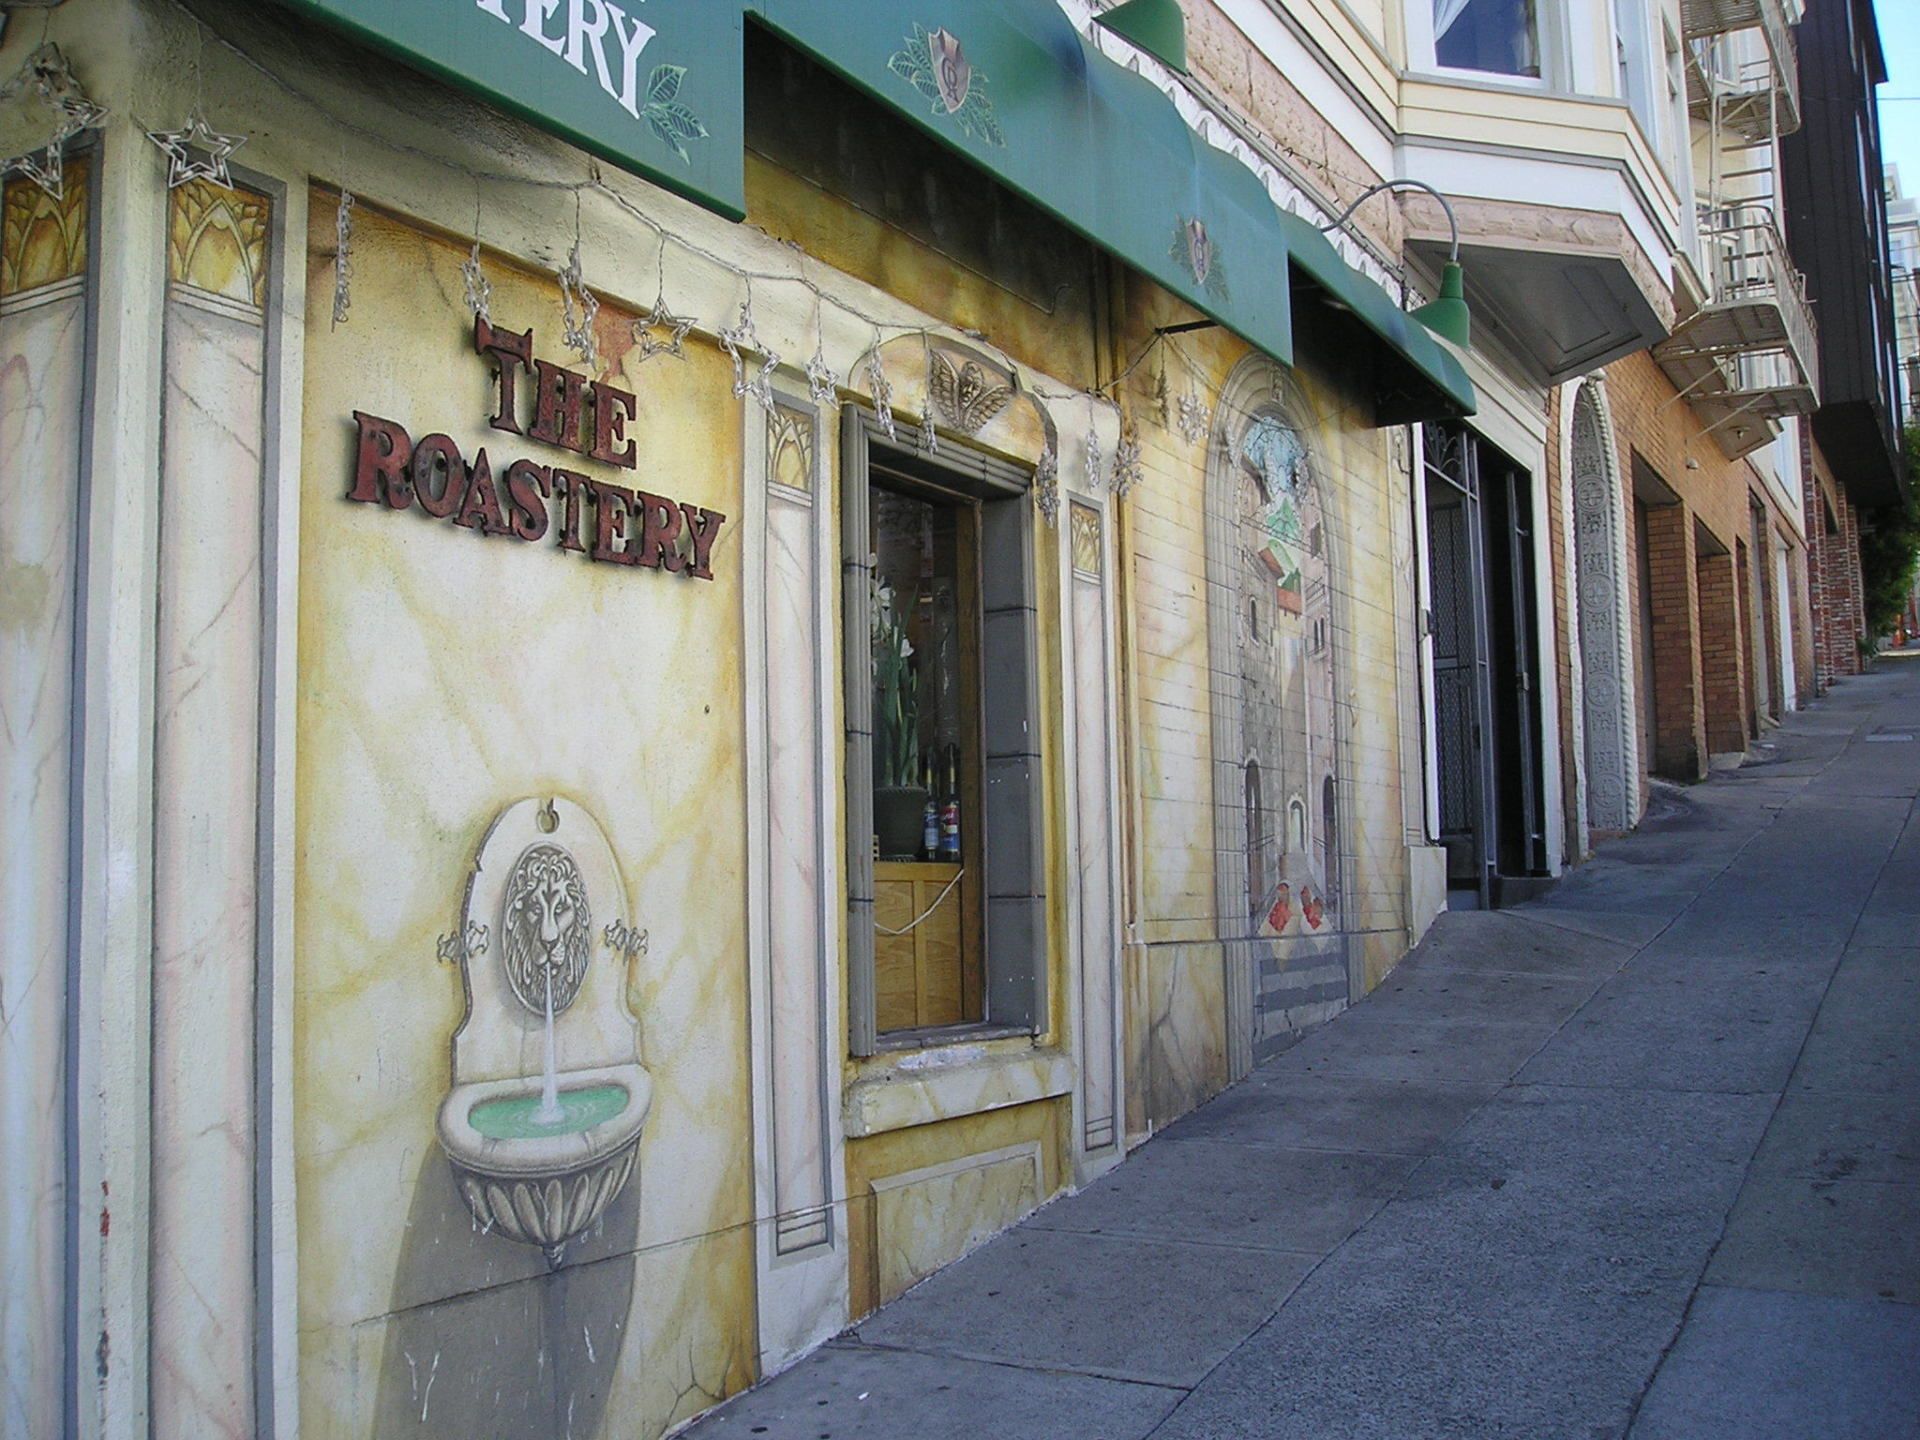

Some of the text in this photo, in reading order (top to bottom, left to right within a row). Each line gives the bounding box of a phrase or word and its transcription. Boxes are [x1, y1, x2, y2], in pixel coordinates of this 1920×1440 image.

[476, 0, 657, 119] ERY
[475, 312, 637, 470] THE
[346, 410, 727, 581] ROASTERY
